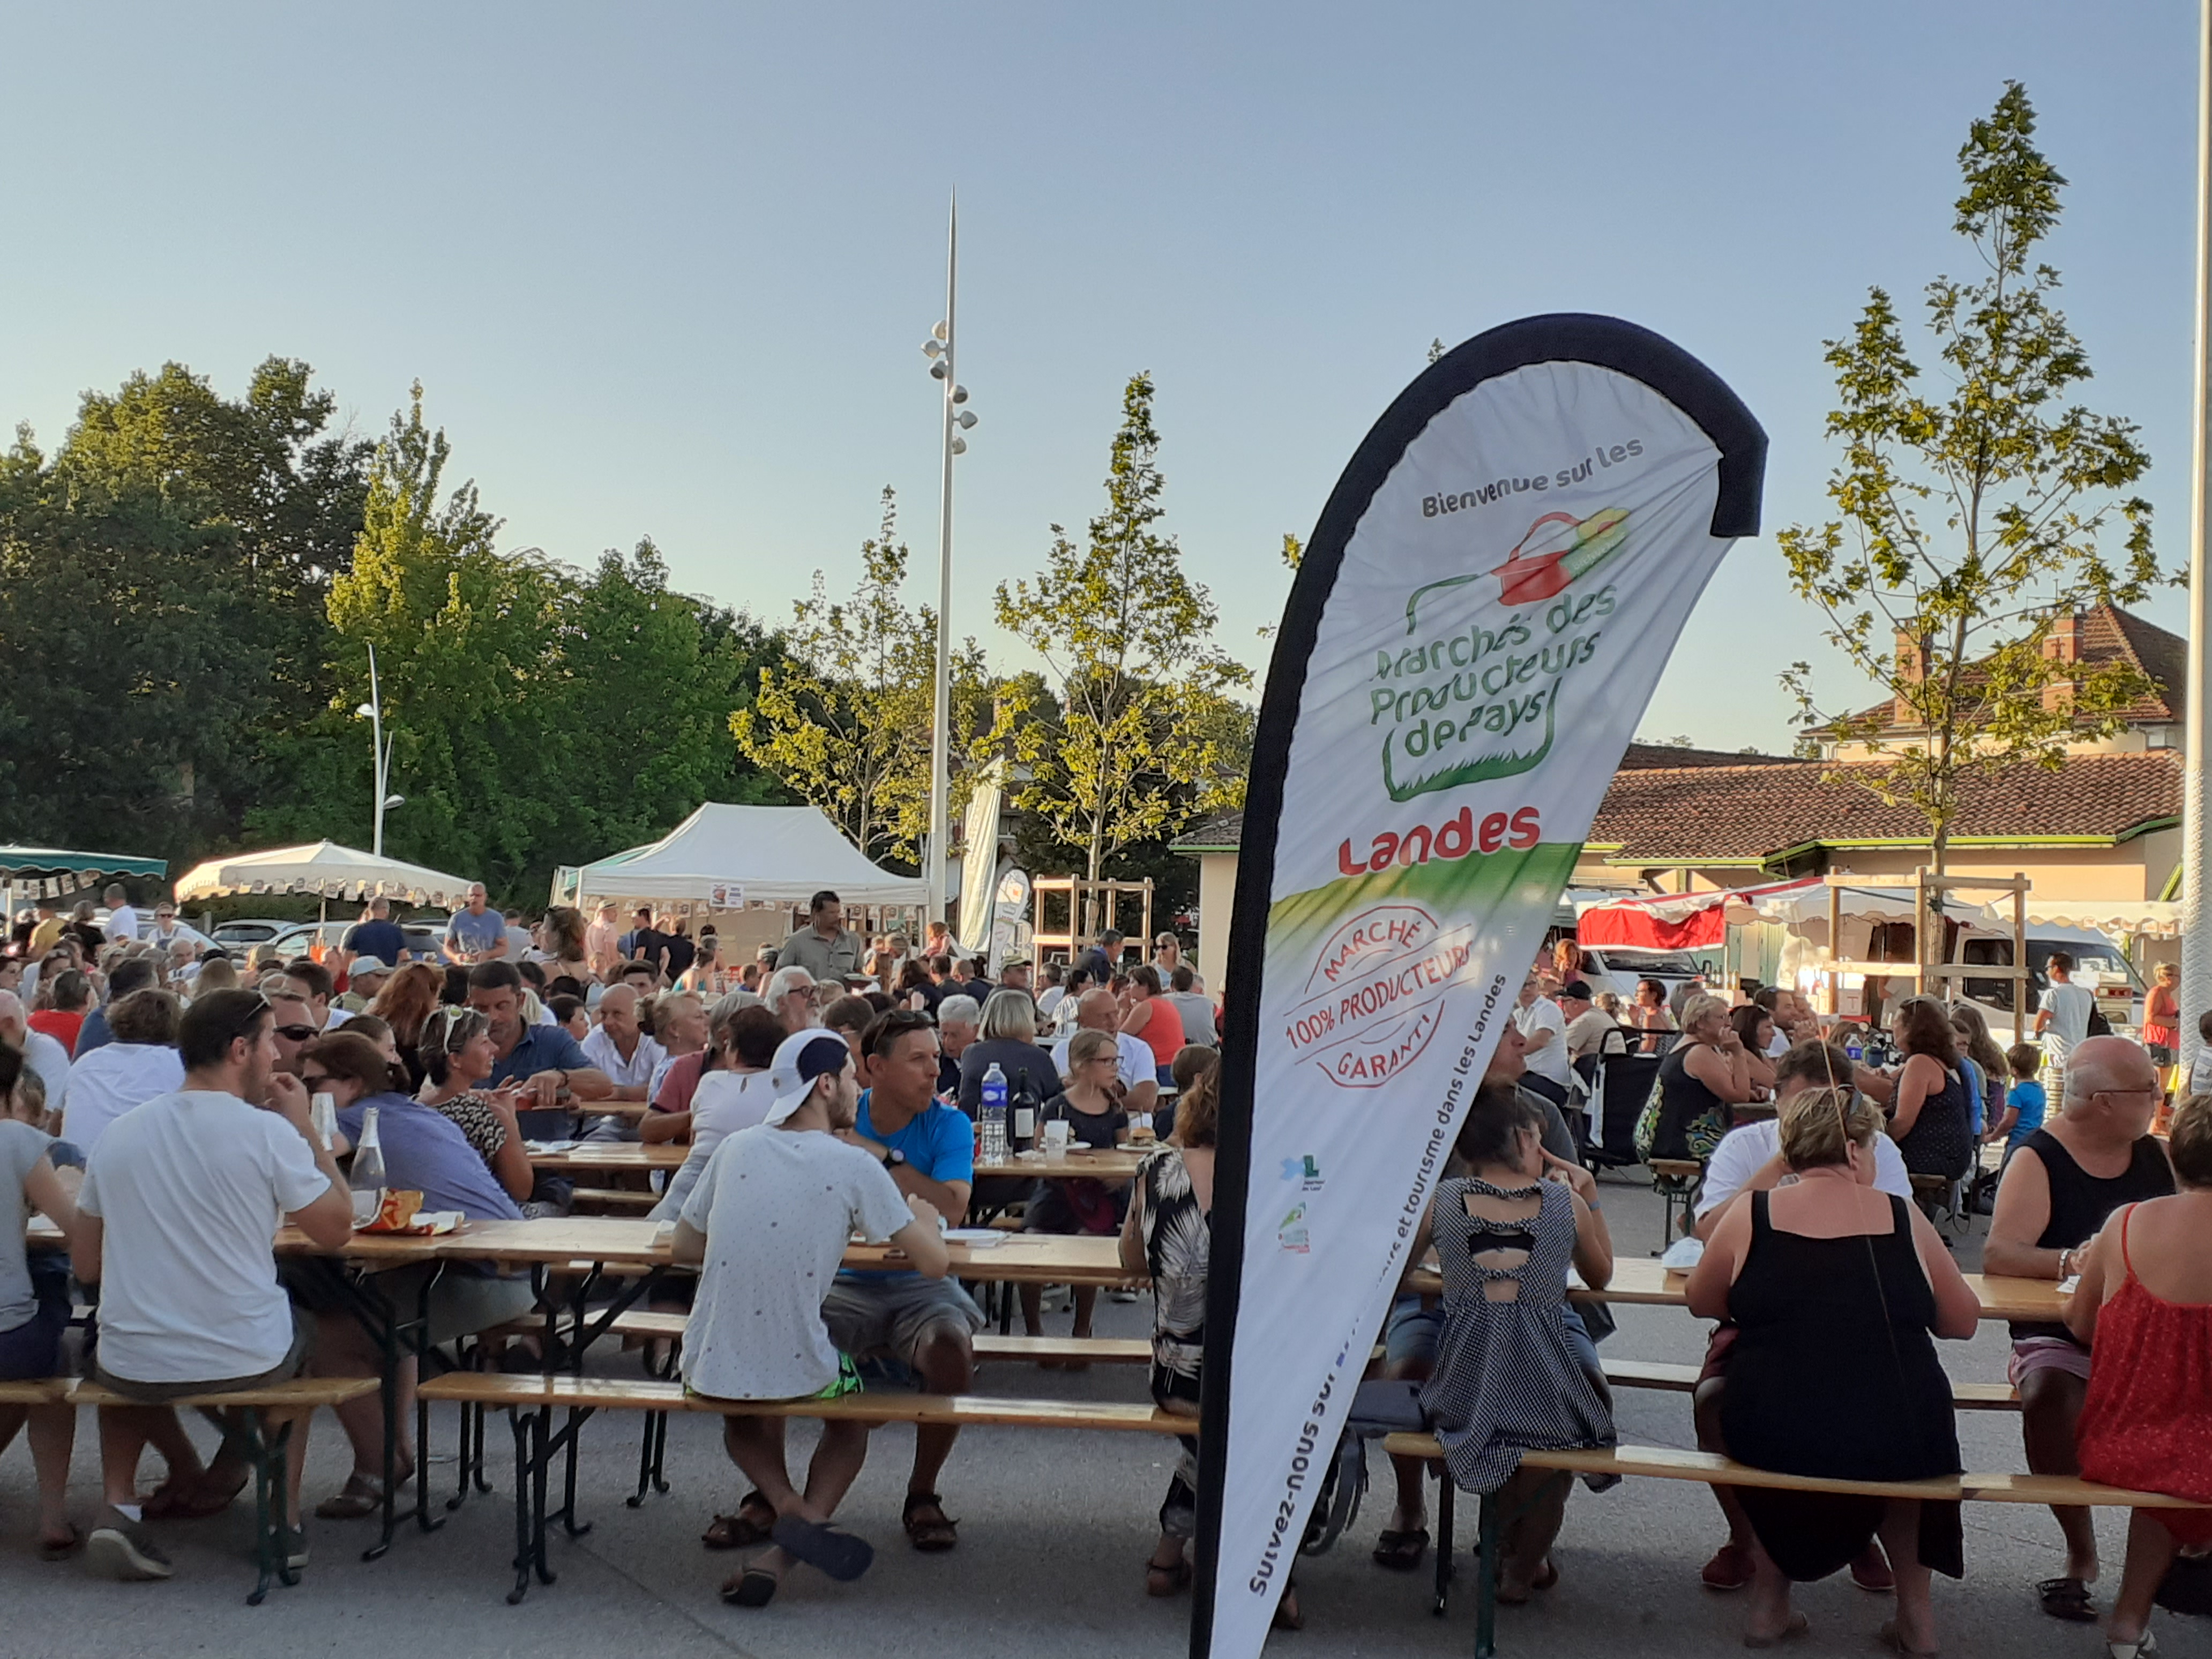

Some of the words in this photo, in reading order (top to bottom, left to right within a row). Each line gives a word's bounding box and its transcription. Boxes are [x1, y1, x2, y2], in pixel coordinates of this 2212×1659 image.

[1423, 475, 1549, 518] Bienvenue
[1556, 457, 1594, 488] sur
[1595, 439, 1644, 468] les
[1546, 584, 1617, 633] des
[1370, 631, 1602, 725] Producteurs
[1404, 719, 1456, 757] de
[1337, 806, 1541, 876] Landes
[1324, 920, 1422, 982] MARCHÉ
[1286, 1005, 1335, 1049] 100%
[1340, 940, 1474, 1025] PRODUCTEURS
[1468, 974, 1506, 1043] Landes
[1337, 1014, 1430, 1079] GARANTI
[1453, 1045, 1476, 1076] les
[1436, 1077, 1464, 1125] dans
[1403, 1127, 1446, 1215] tourisme
[1396, 1216, 1413, 1238] et
[1249, 1420, 1319, 1597] Suivez-nous
